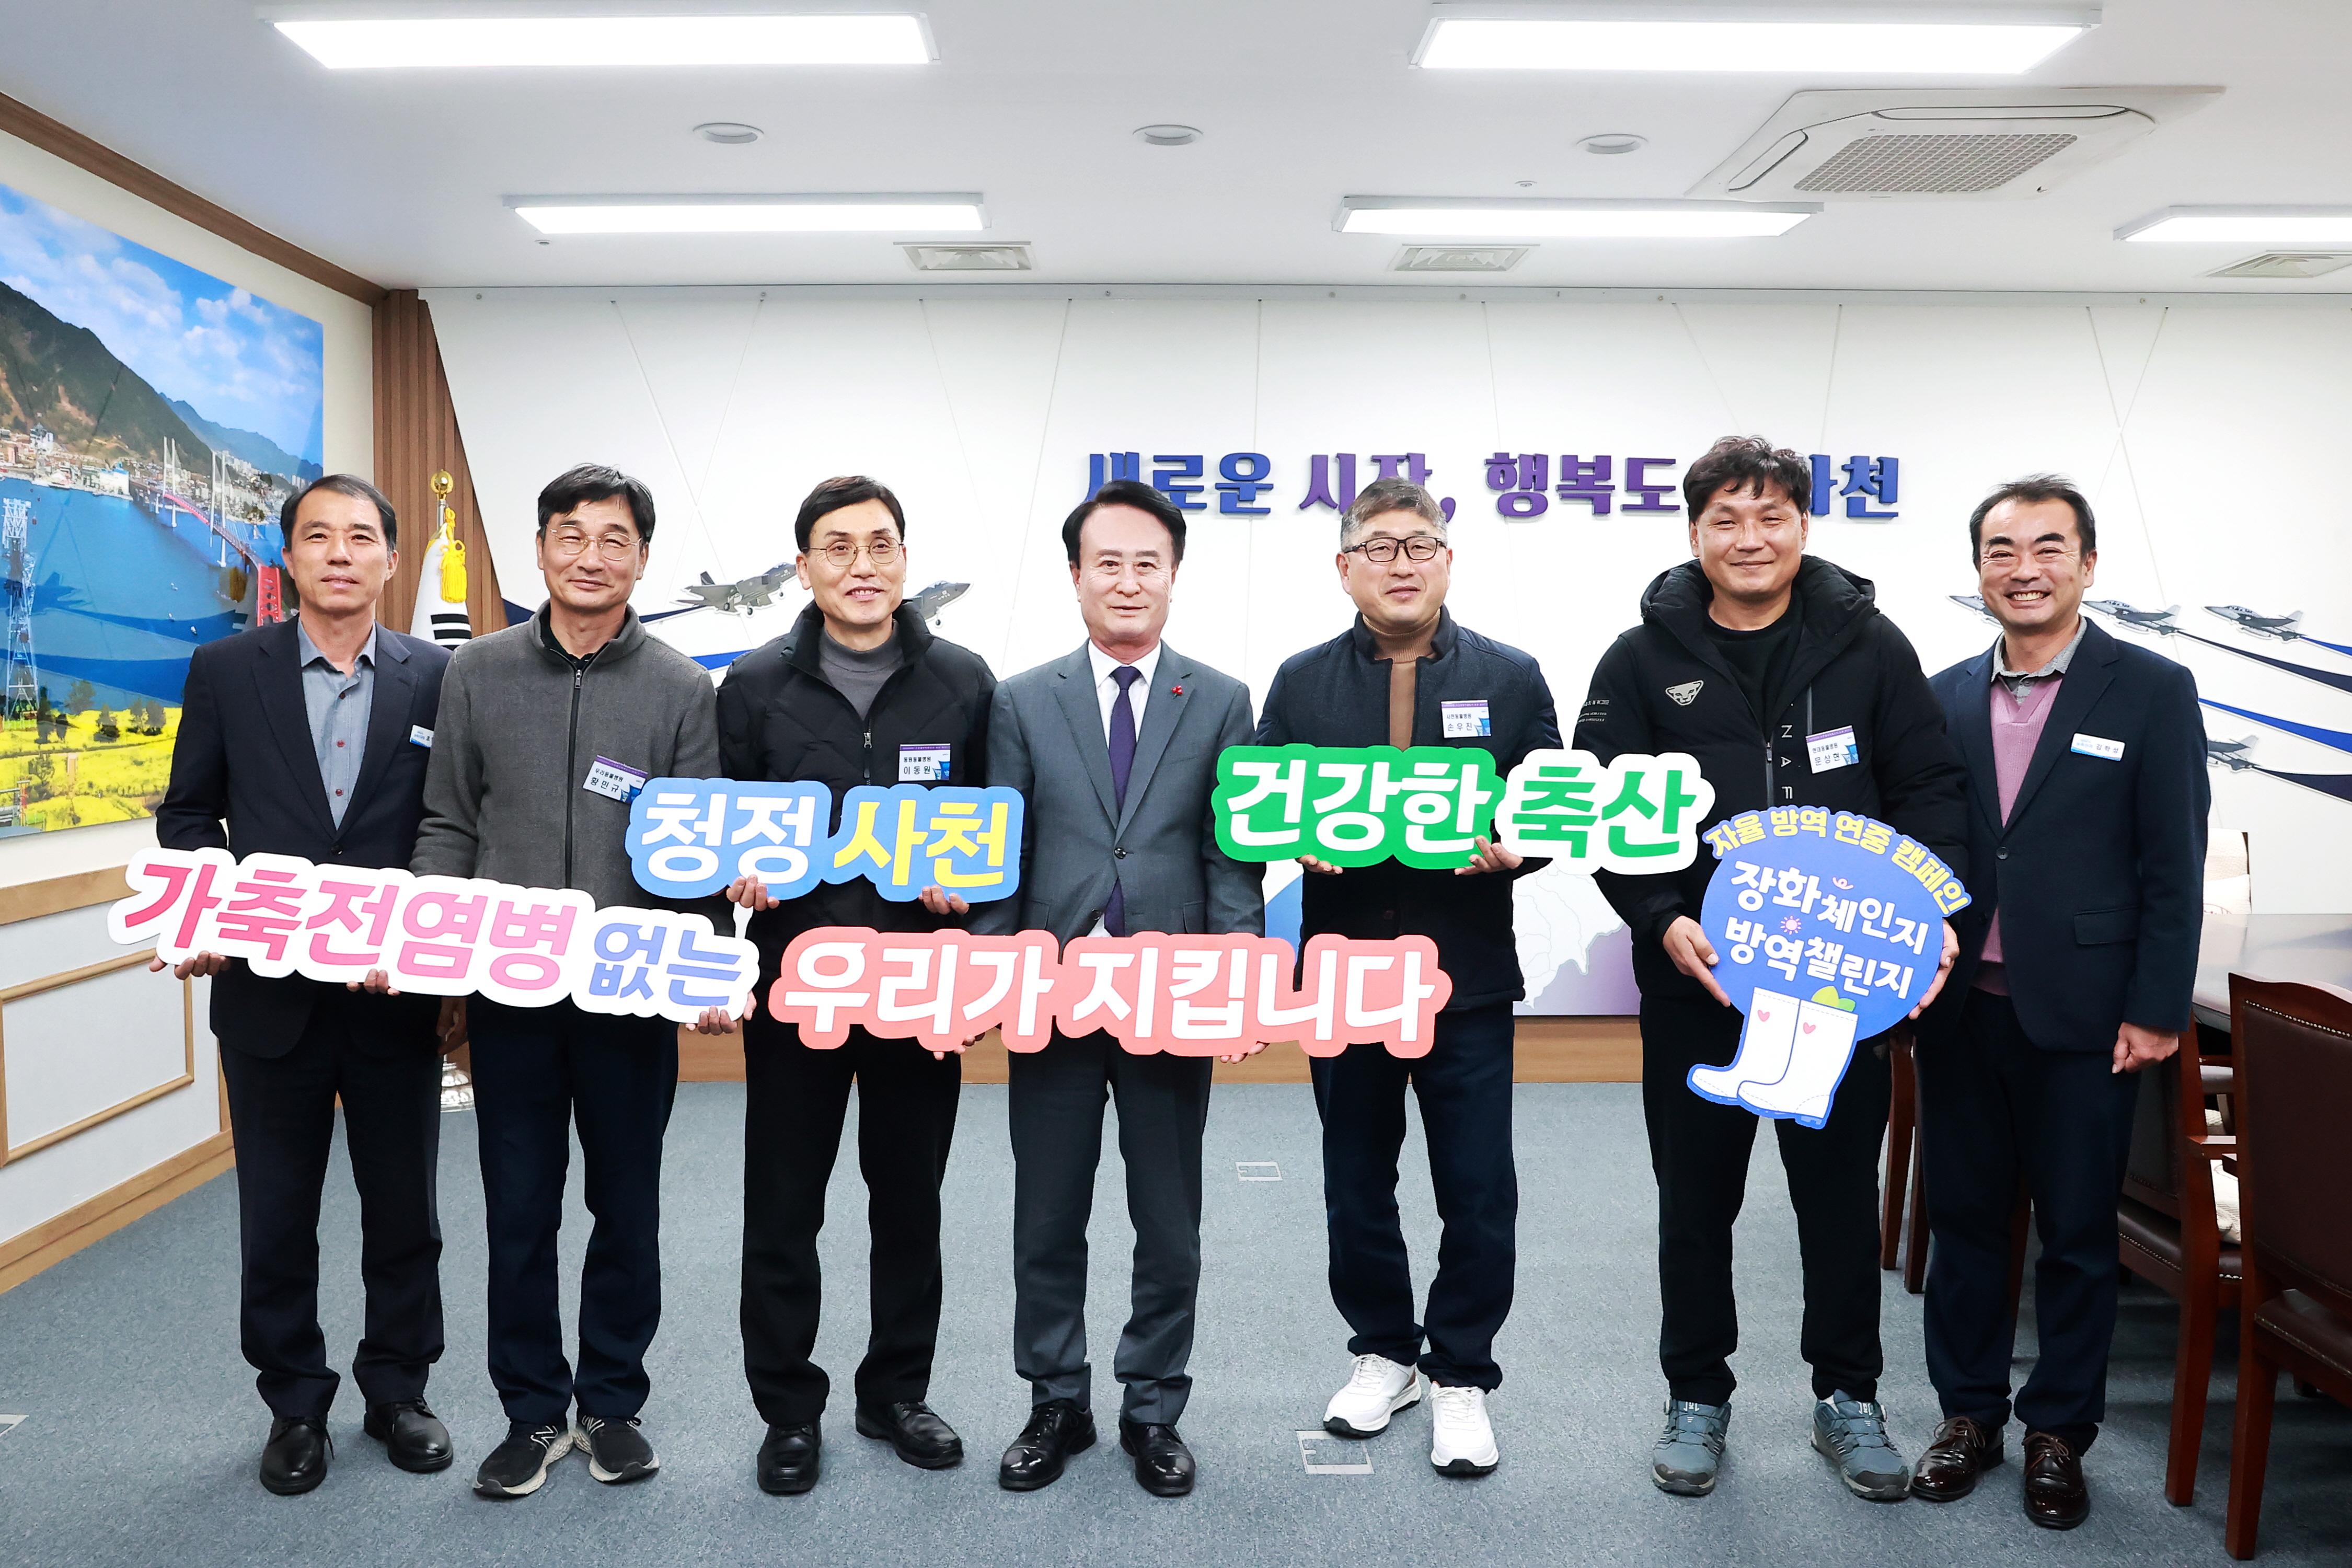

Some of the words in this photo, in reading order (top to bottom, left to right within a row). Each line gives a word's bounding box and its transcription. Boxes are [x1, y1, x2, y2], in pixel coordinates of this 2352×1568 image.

[1484, 452, 1680, 517] 행복도
[595, 768, 624, 782] 우리동물병원
[1227, 759, 1492, 853] 건강한
[1512, 766, 1697, 858] 축산
[642, 793, 816, 885] 청정
[834, 800, 1008, 887] 사천
[1707, 814, 1767, 857] 자율
[1770, 809, 1827, 838] 방역
[1835, 815, 1893, 855] 연중
[1891, 839, 1968, 915] 캠페인
[124, 863, 577, 990] 가축전염병
[589, 923, 742, 1007] 없는
[785, 942, 1055, 1036] 우리가
[1073, 947, 1436, 1042] 지킵니다
